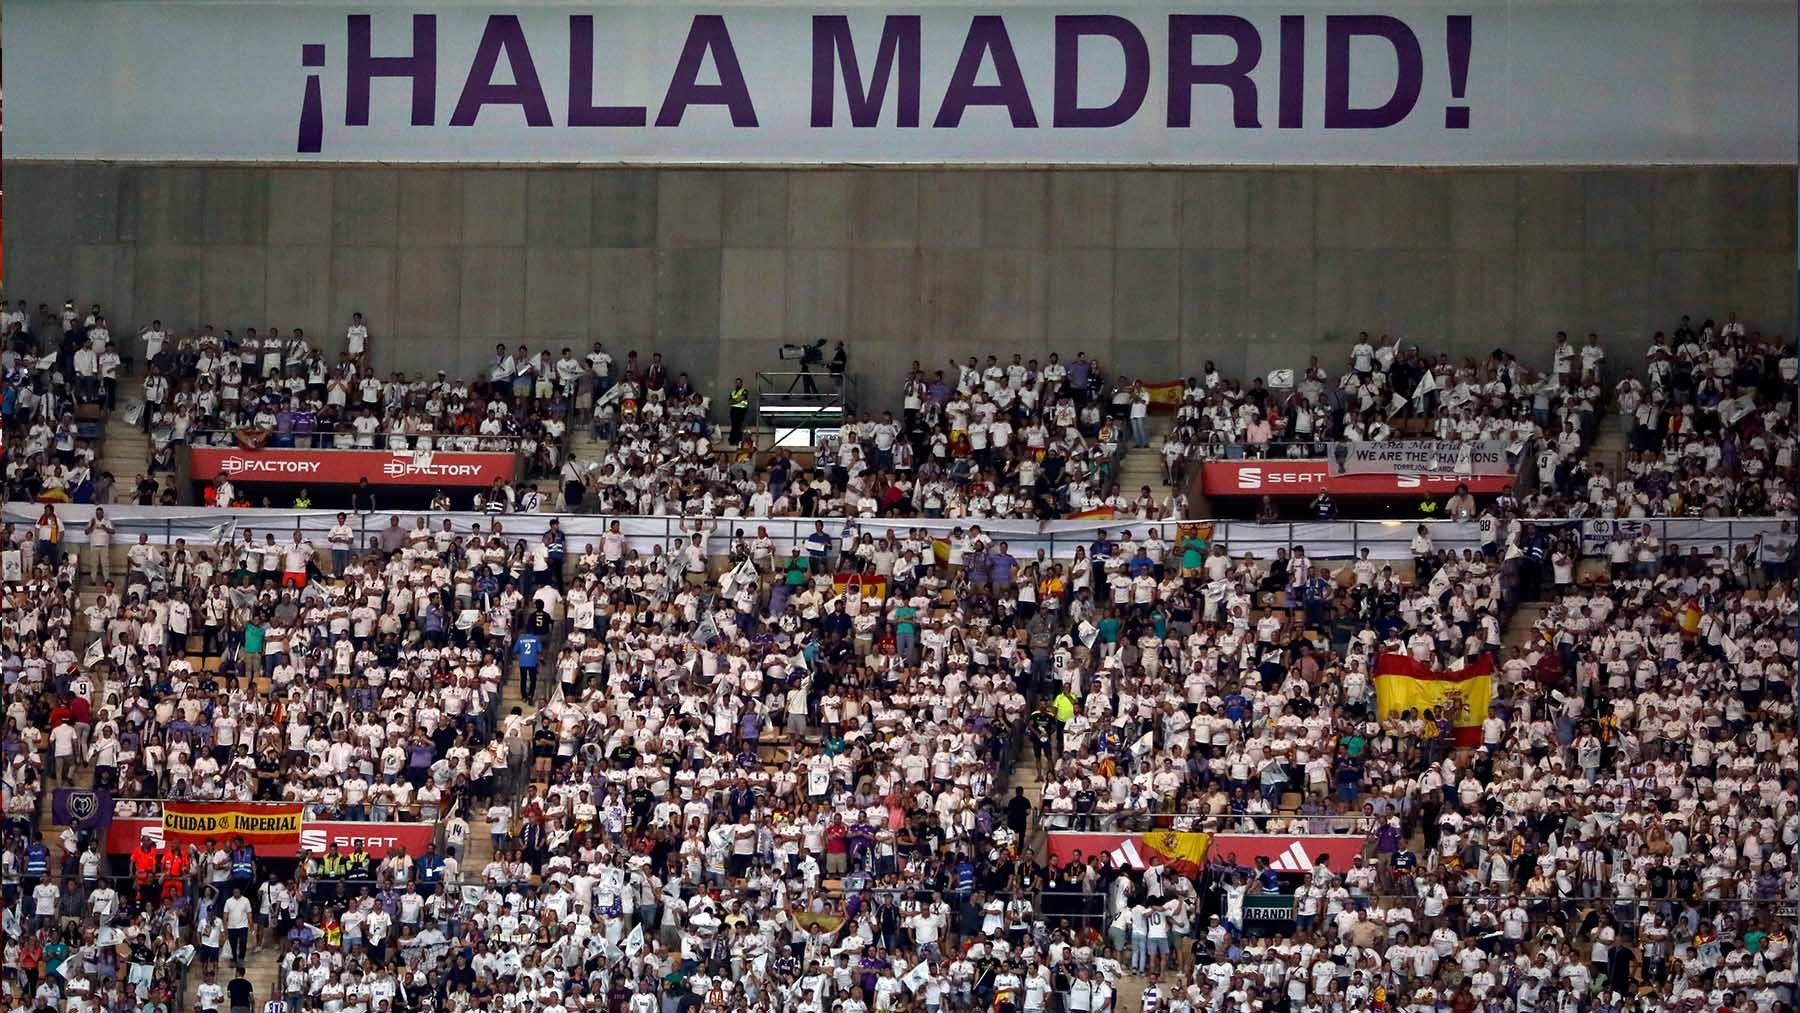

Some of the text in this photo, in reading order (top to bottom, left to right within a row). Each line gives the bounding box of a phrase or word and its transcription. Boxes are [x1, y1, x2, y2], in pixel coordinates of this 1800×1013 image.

[297, 14, 1472, 153] ¡HALA MADRID!
[1356, 450, 1377, 461] WE
[1379, 451, 1402, 461] ARE
[1405, 452, 1428, 462] THE
[244, 461, 320, 472] FACTORY
[1541, 457, 1548, 468] 9
[1268, 473, 1327, 483] SEAT
[536, 616, 543, 627] 5
[524, 643, 532, 654] 2
[1056, 655, 1063, 668] 9
[79, 683, 87, 695] 9
[165, 814, 297, 831] CIUDAD IMPERIAL
[452, 823, 463, 836] 14
[334, 836, 398, 848] SEAT
[1150, 911, 1161, 926] 10
